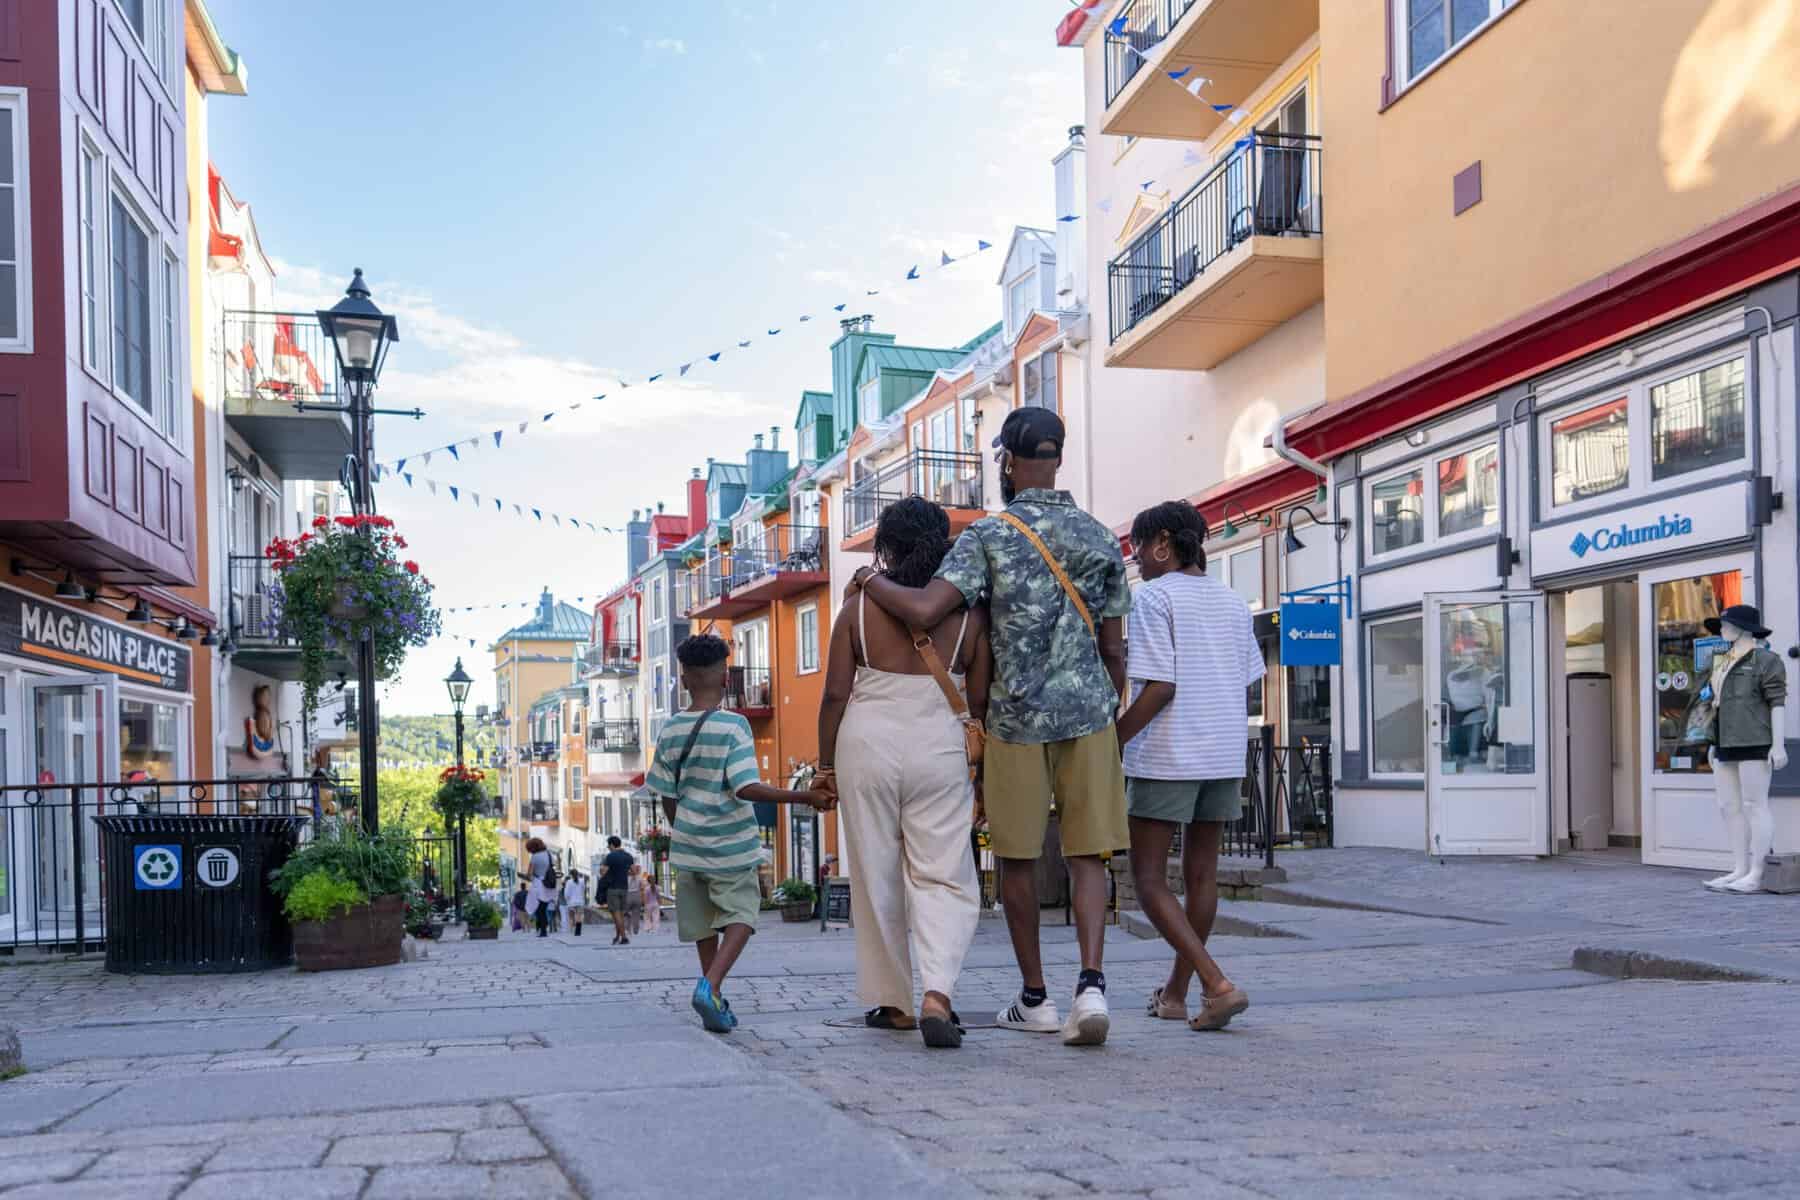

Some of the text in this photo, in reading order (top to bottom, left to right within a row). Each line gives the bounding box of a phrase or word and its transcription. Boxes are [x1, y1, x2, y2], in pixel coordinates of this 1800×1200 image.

[1591, 513, 1692, 551] Columbia
[21, 601, 121, 663] MAGASIN
[127, 636, 177, 677] PLACE
[1299, 629, 1337, 640] Columbia
